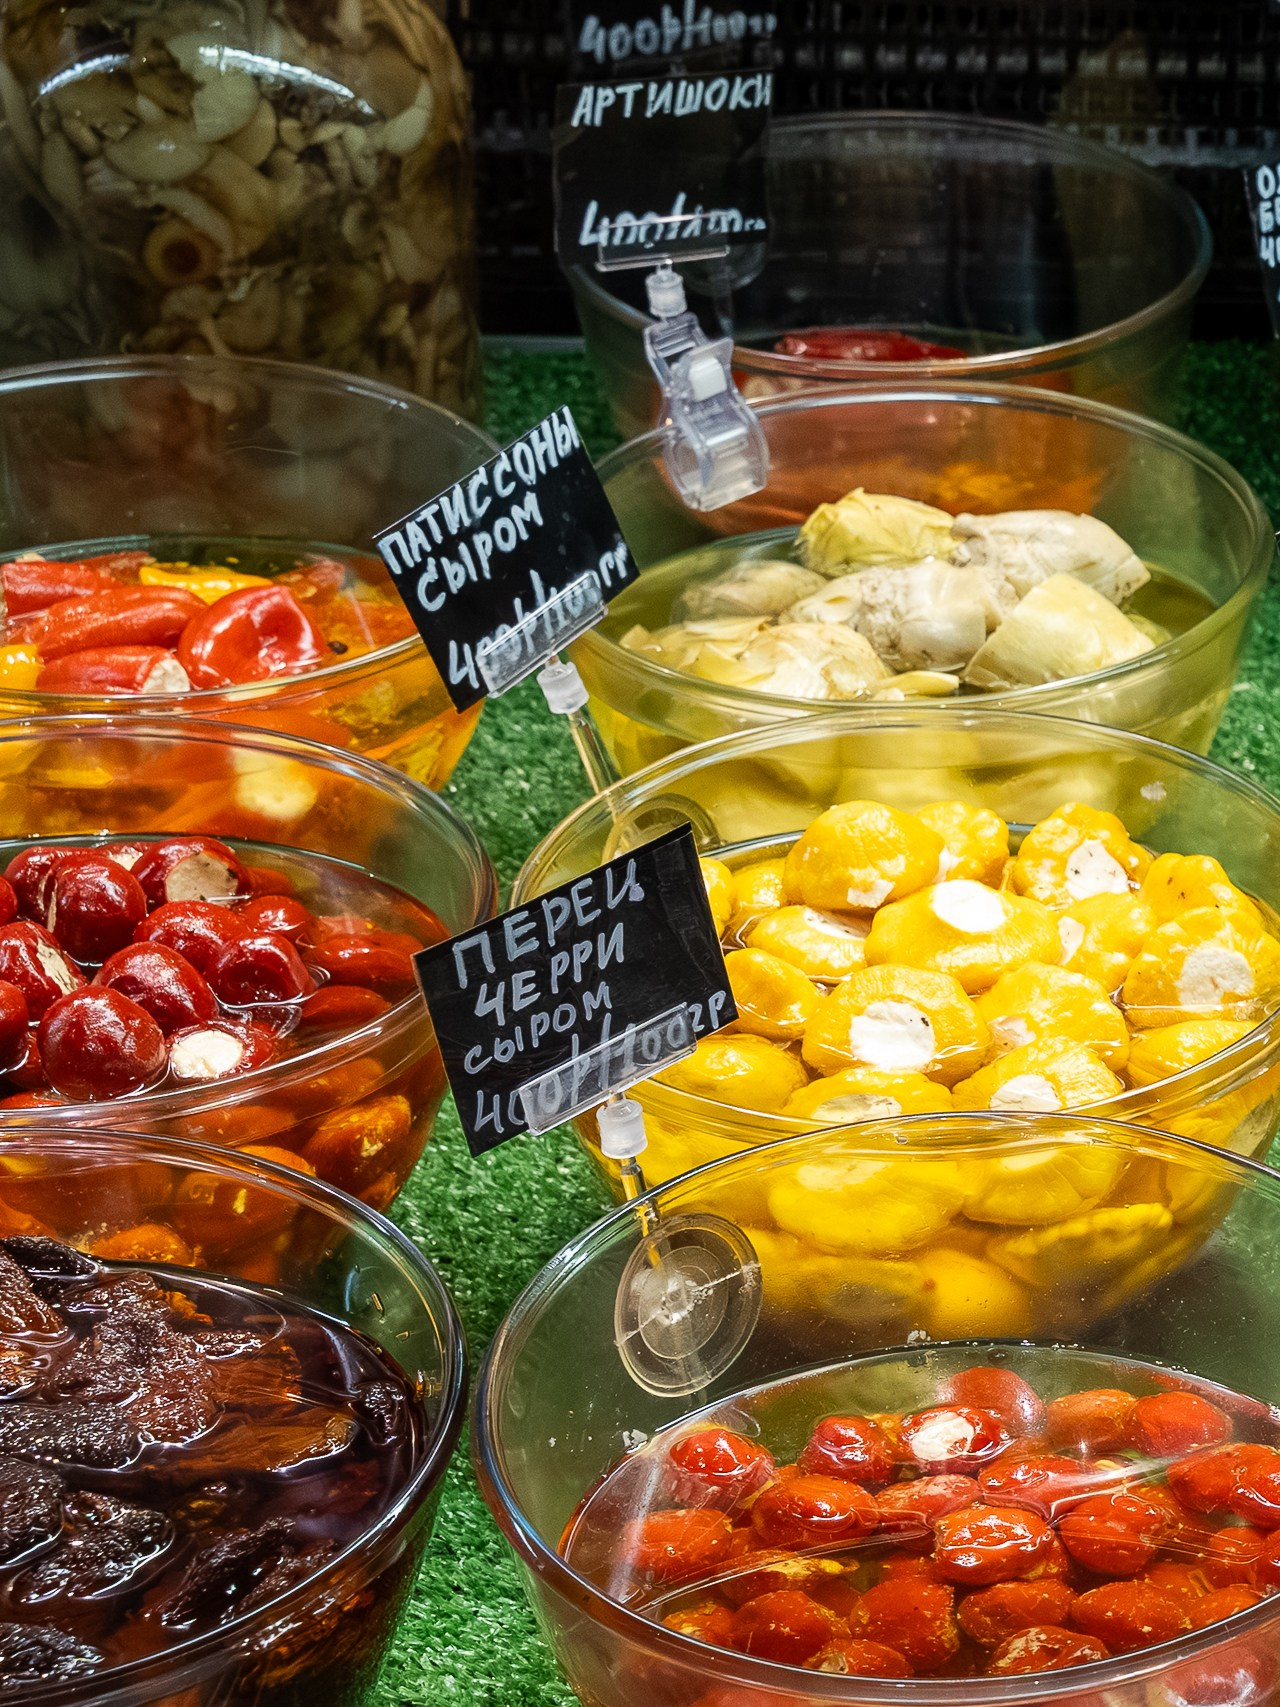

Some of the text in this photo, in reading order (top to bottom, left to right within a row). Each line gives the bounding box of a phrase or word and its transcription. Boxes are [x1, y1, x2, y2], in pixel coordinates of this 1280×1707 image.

[571, 73, 772, 127] АРТИШОКИ
[376, 405, 580, 575] ПАТИССОНЫ
[452, 858, 644, 989] ПЕРЕЦ
[474, 922, 624, 1026] ЧЕРРИ
